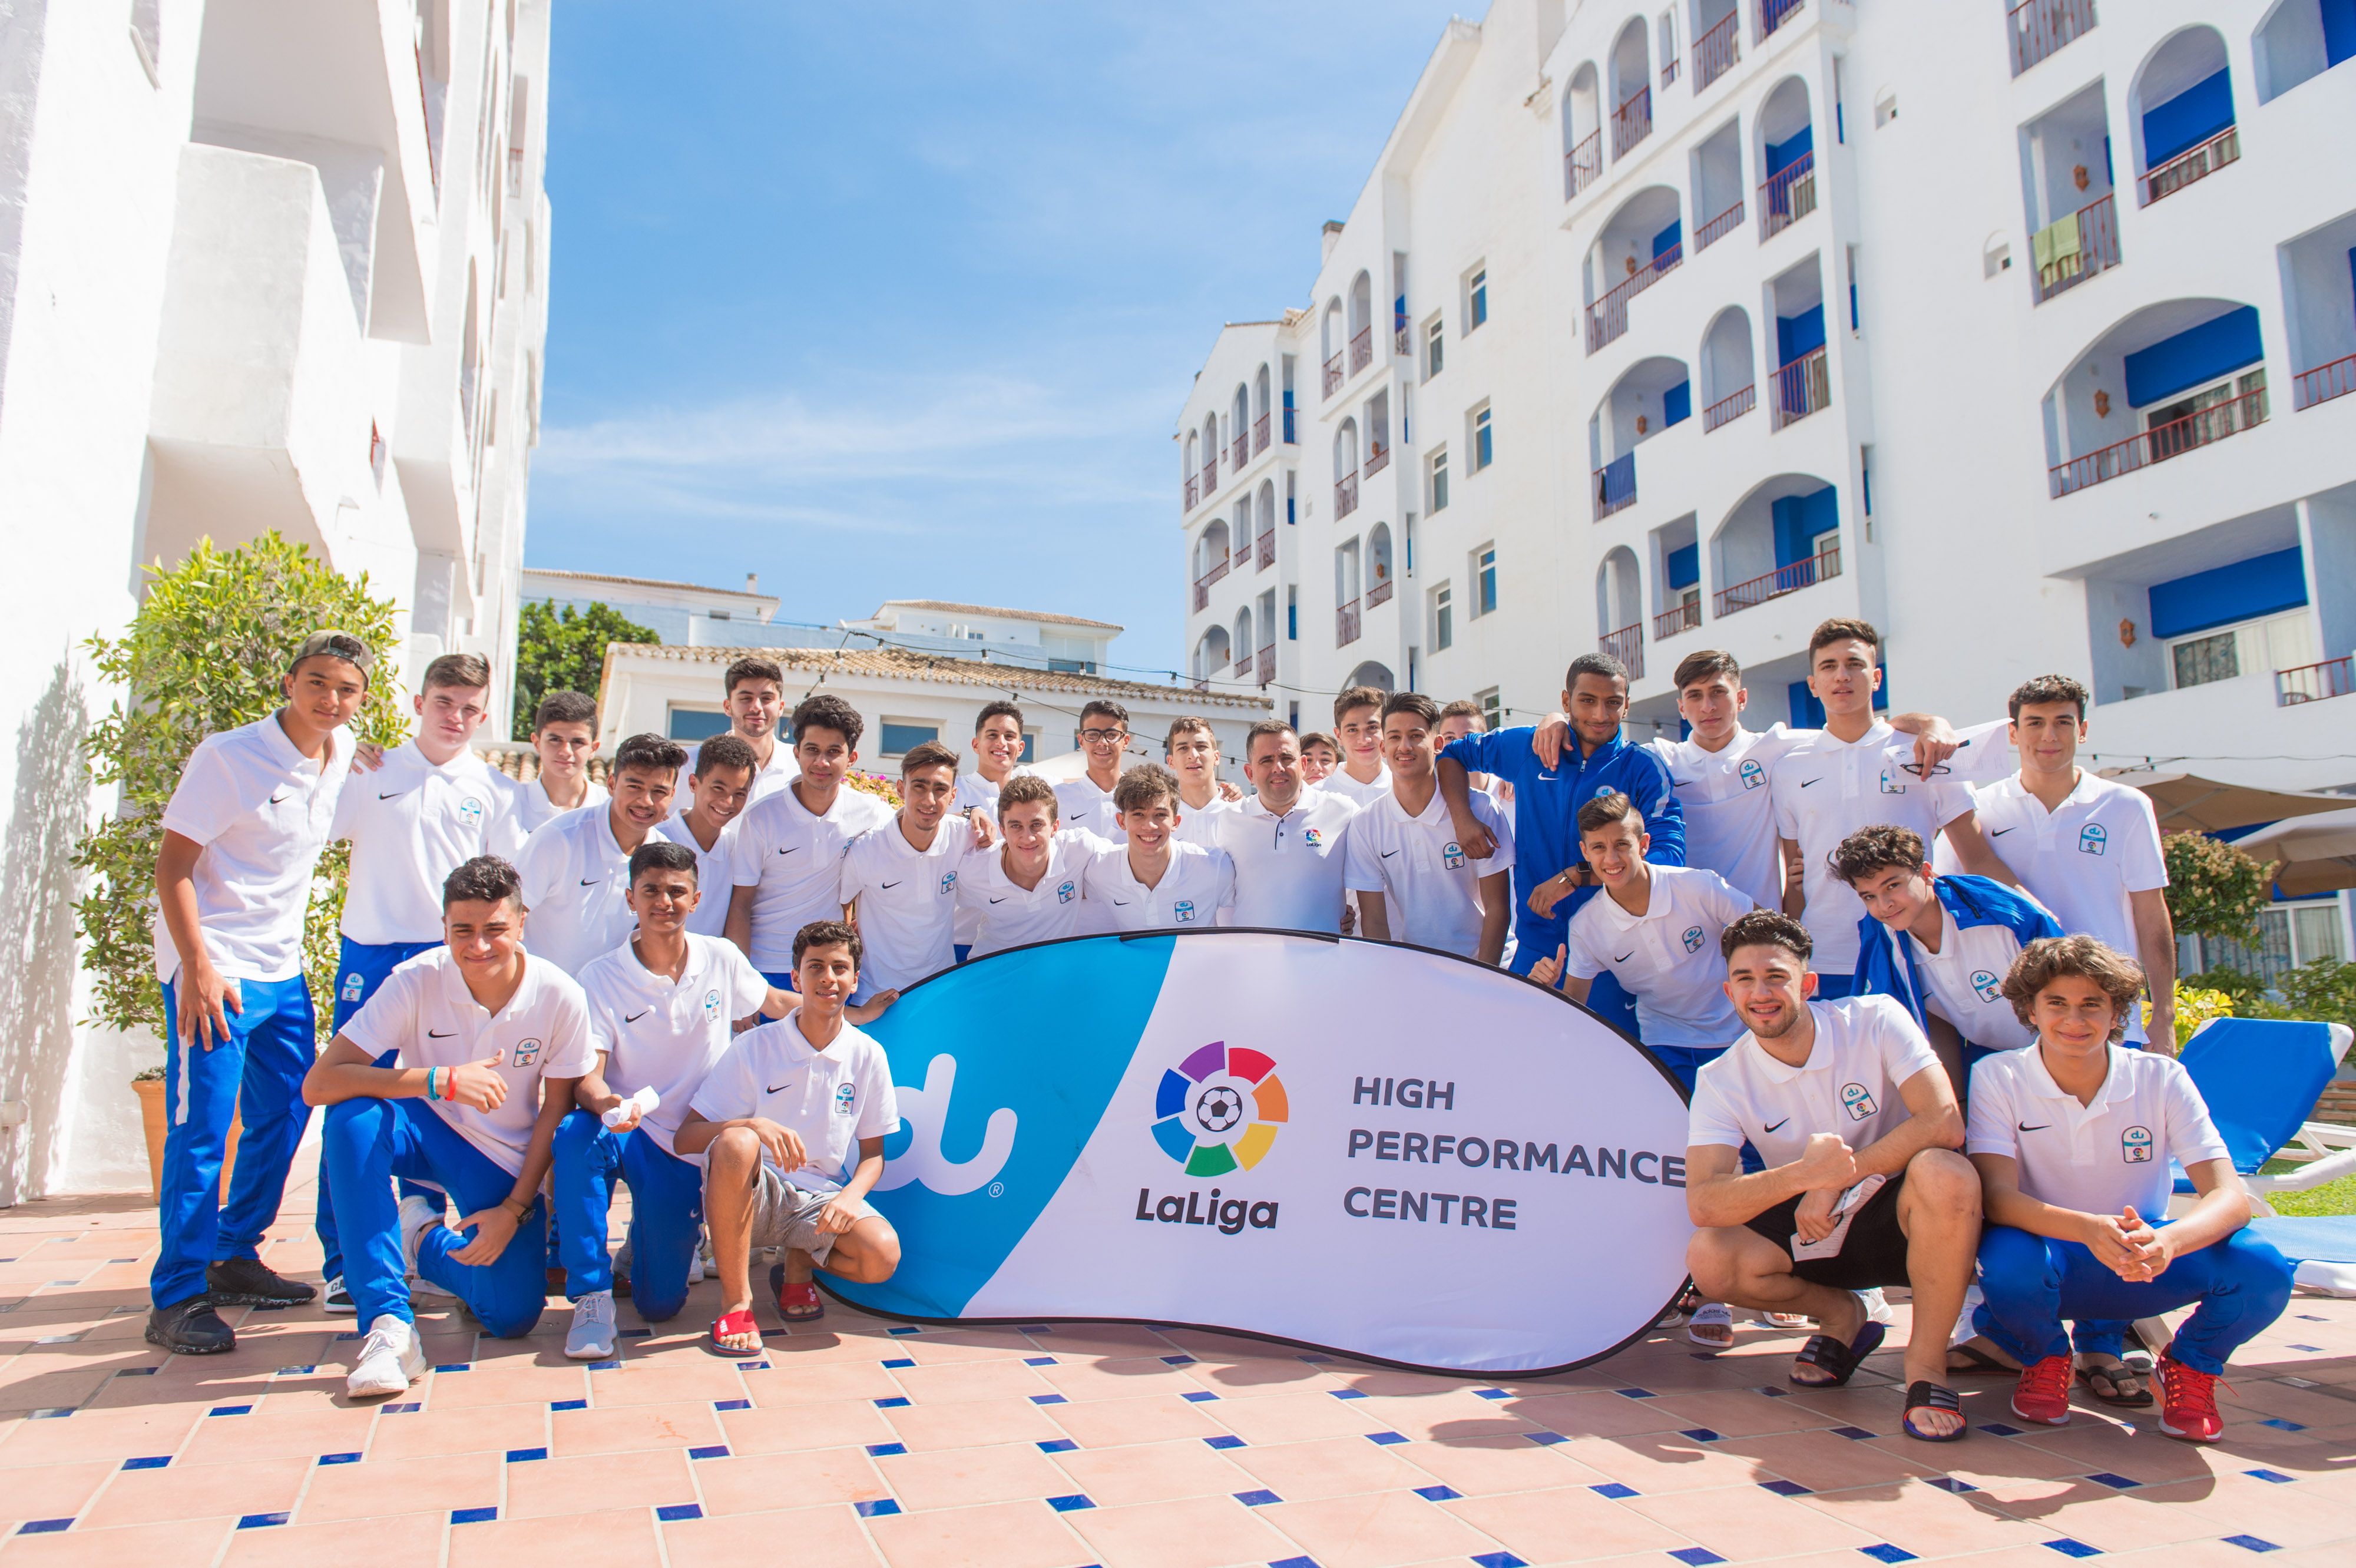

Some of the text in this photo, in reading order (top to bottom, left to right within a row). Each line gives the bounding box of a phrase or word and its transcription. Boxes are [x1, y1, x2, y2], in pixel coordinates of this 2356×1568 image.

[1353, 1076, 1455, 1110] HIGH
[2132, 1131, 2144, 1139] du
[1348, 1129, 1686, 1187] PERFORMANCE
[1136, 1187, 1279, 1235] LaLiga
[1344, 1186, 1517, 1230] CENTRE
